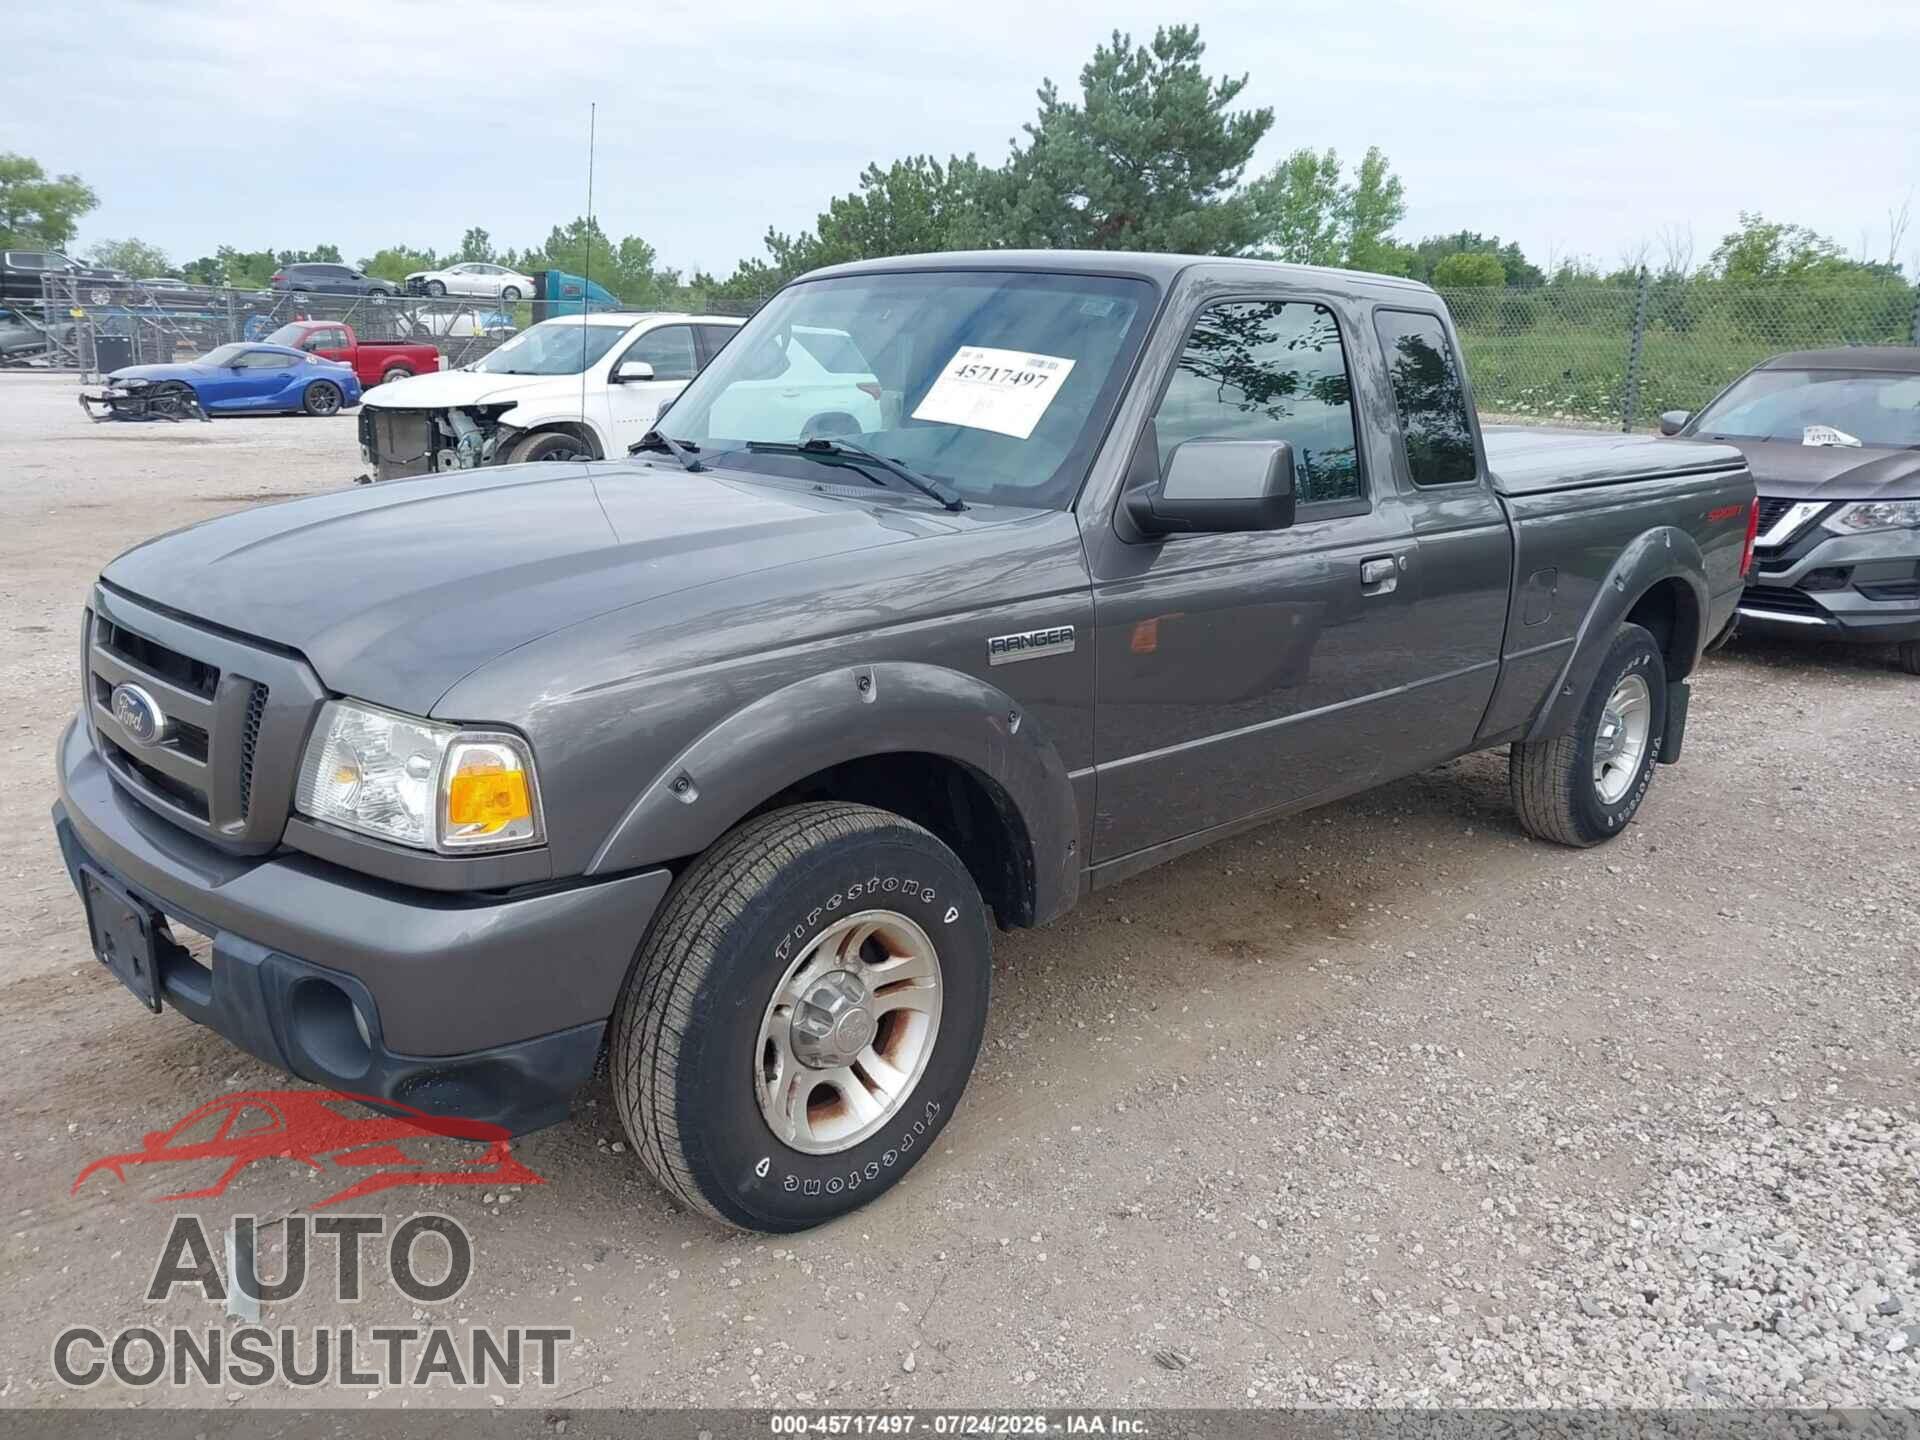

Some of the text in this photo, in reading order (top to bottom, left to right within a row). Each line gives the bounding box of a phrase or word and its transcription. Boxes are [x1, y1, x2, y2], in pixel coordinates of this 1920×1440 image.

[954, 363, 1049, 389] 45717497
[991, 628, 1074, 654] RANGER
[117, 692, 143, 732] Ford
[774, 876, 937, 961] Firestone
[783, 1101, 941, 1195] Firestone
